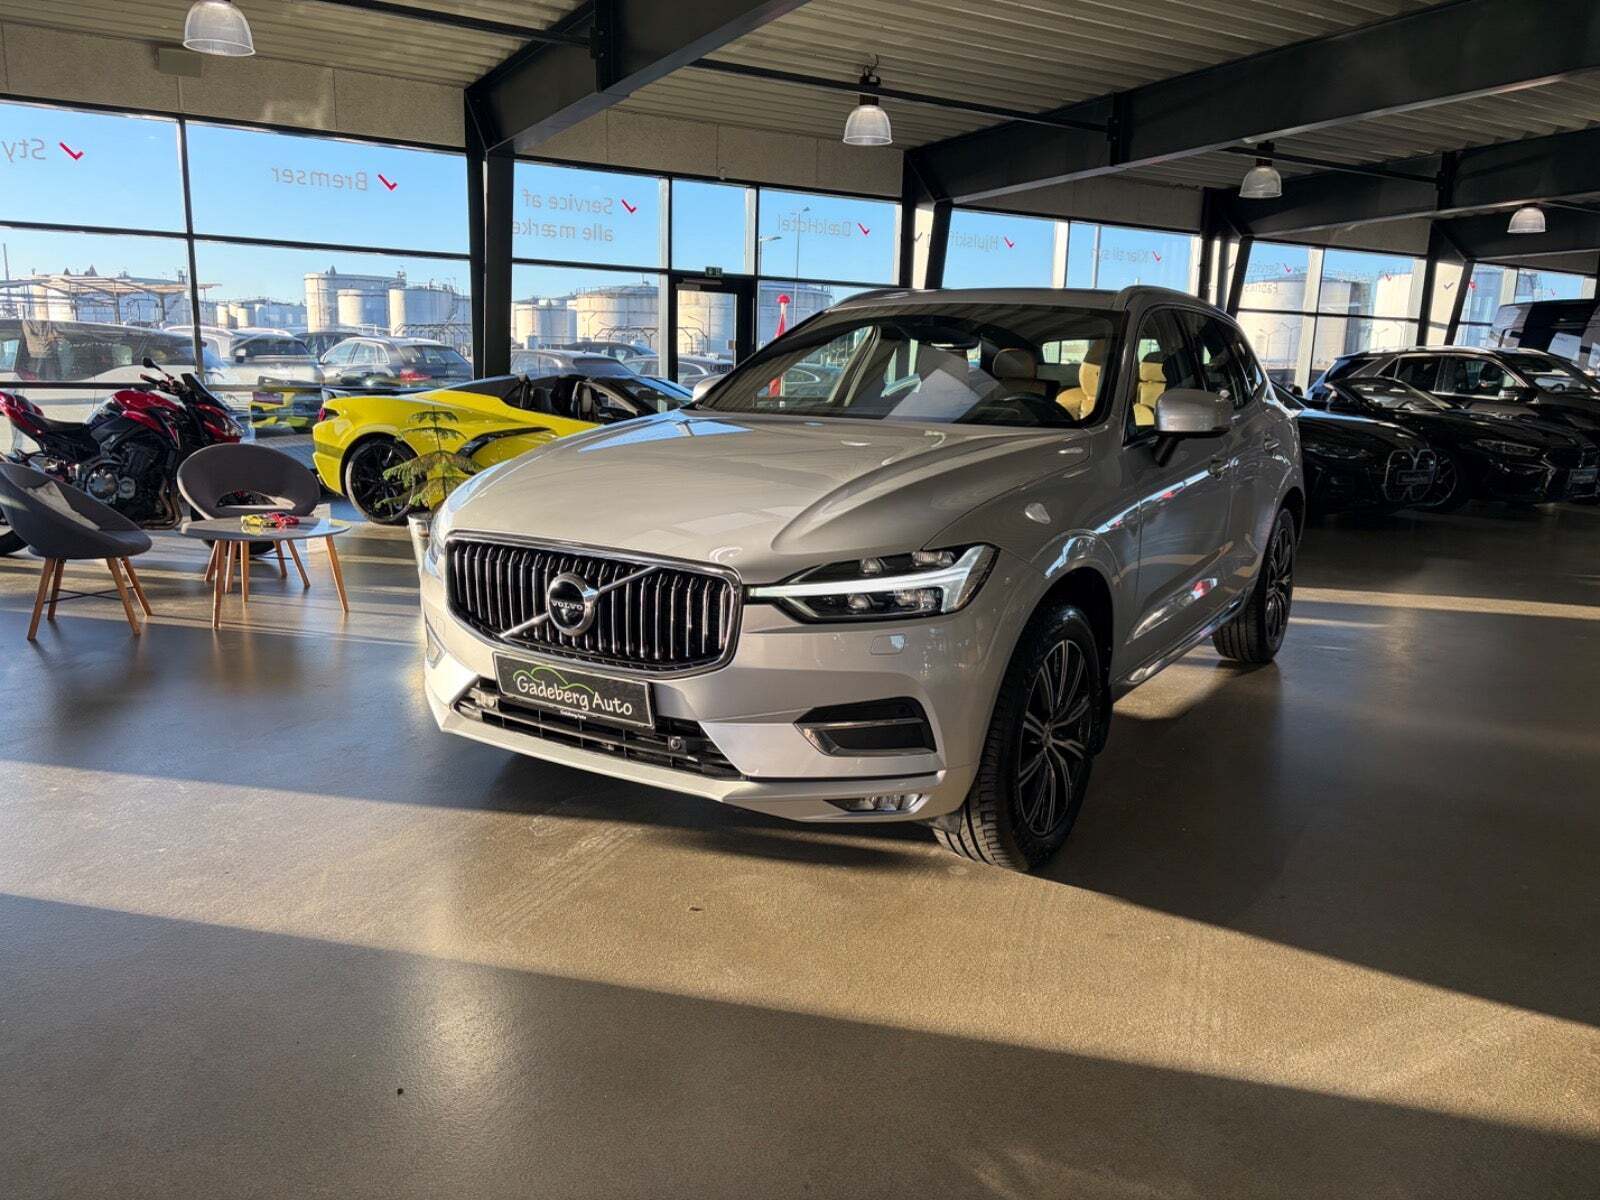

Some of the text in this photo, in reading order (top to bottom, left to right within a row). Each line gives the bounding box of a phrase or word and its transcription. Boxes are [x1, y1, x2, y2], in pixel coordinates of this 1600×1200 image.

[551, 599, 584, 611] VOLVO
[516, 675, 633, 716] Gadeberg Auto
